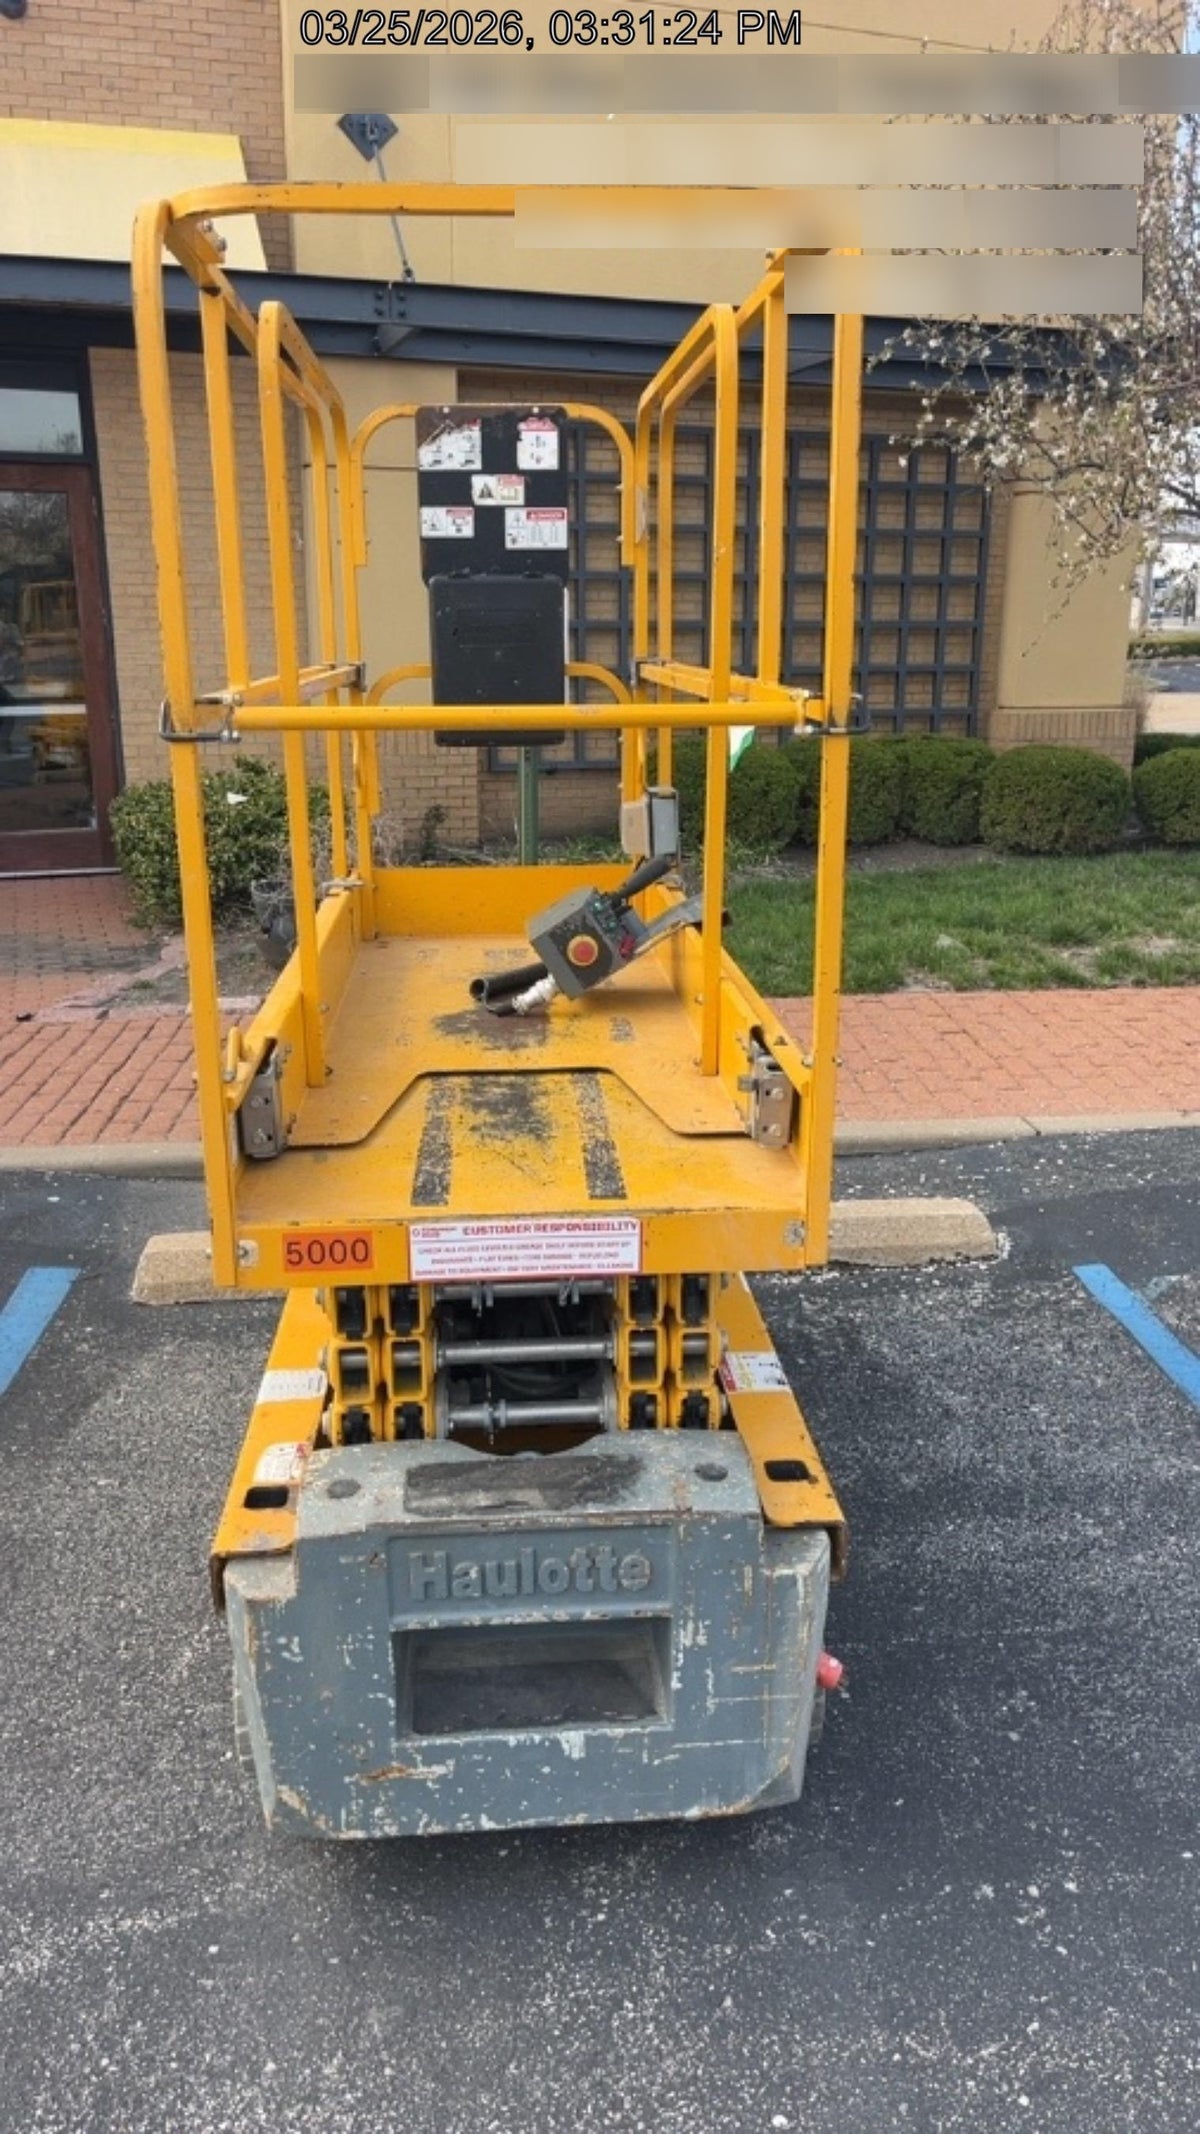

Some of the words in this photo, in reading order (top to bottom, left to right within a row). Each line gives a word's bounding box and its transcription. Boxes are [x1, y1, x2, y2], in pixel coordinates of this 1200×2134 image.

[462, 1224, 532, 1236] CUSTOMER
[533, 1221, 637, 1234] RESPONSIBILITY
[287, 1238, 369, 1266] 5000
[408, 1545, 652, 1600] Haulotte
